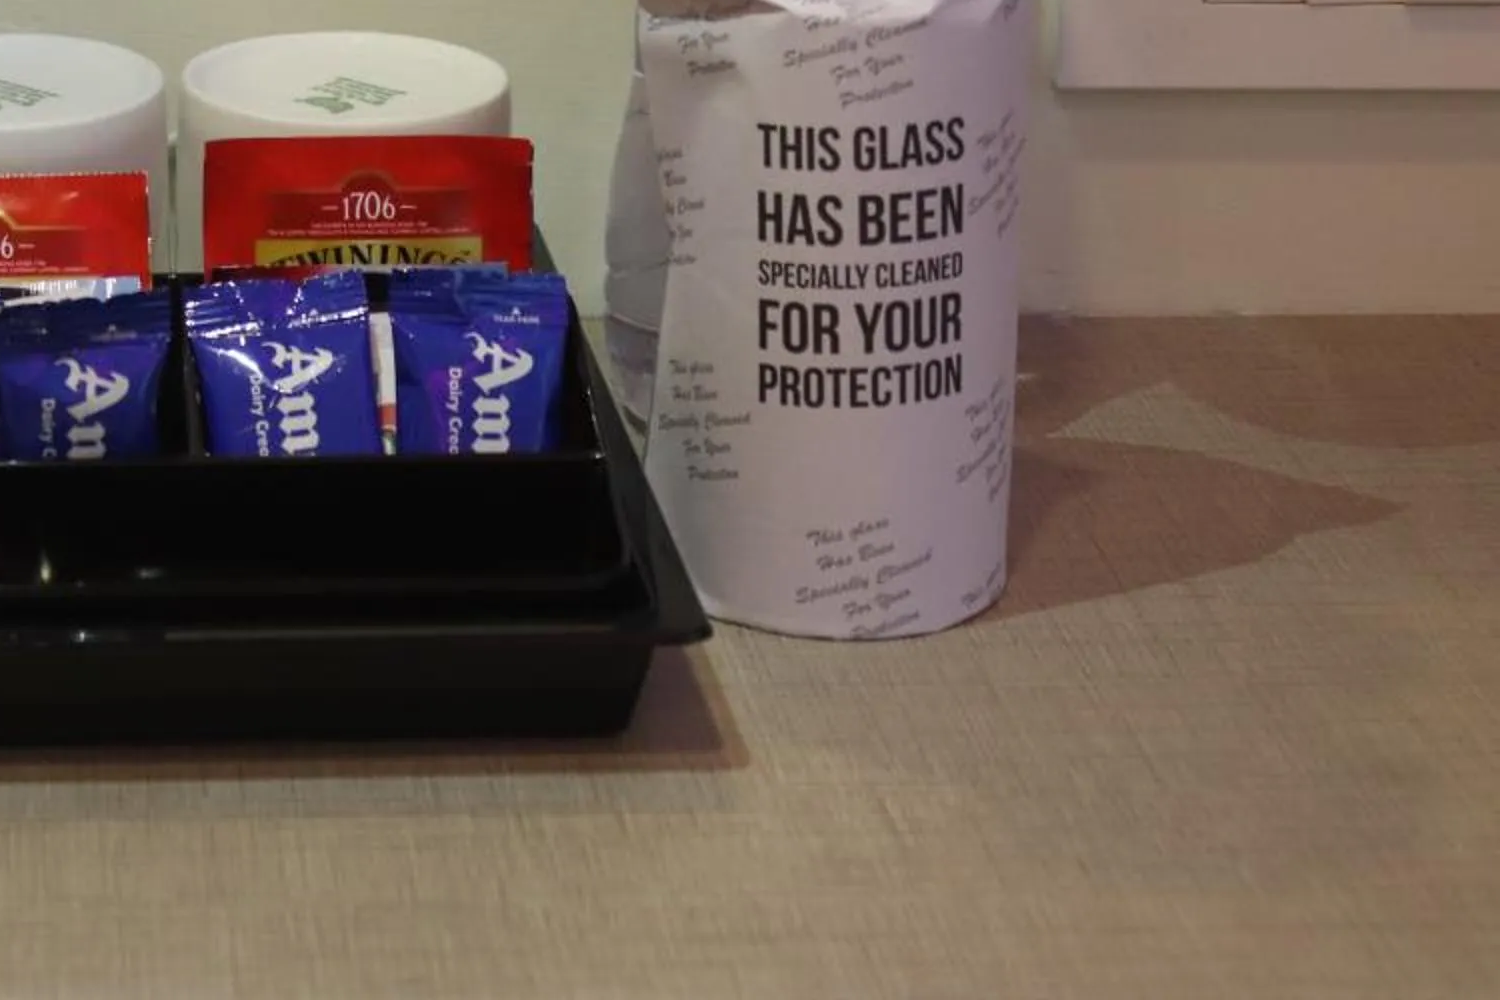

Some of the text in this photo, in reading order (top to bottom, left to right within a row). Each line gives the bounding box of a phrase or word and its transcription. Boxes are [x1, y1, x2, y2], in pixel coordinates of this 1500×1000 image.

[756, 121, 841, 173] THIS
[853, 116, 965, 172] GLASS
[342, 191, 396, 221] 1706
[757, 190, 843, 247] HAS
[858, 183, 964, 247] BEEN
[267, 243, 467, 266] WININ
[757, 251, 963, 290] SPECIALLY CLEANED
[758, 292, 962, 355] FOR YOUR
[445, 367, 463, 412] Dairy
[758, 353, 962, 409] PROTECTION
